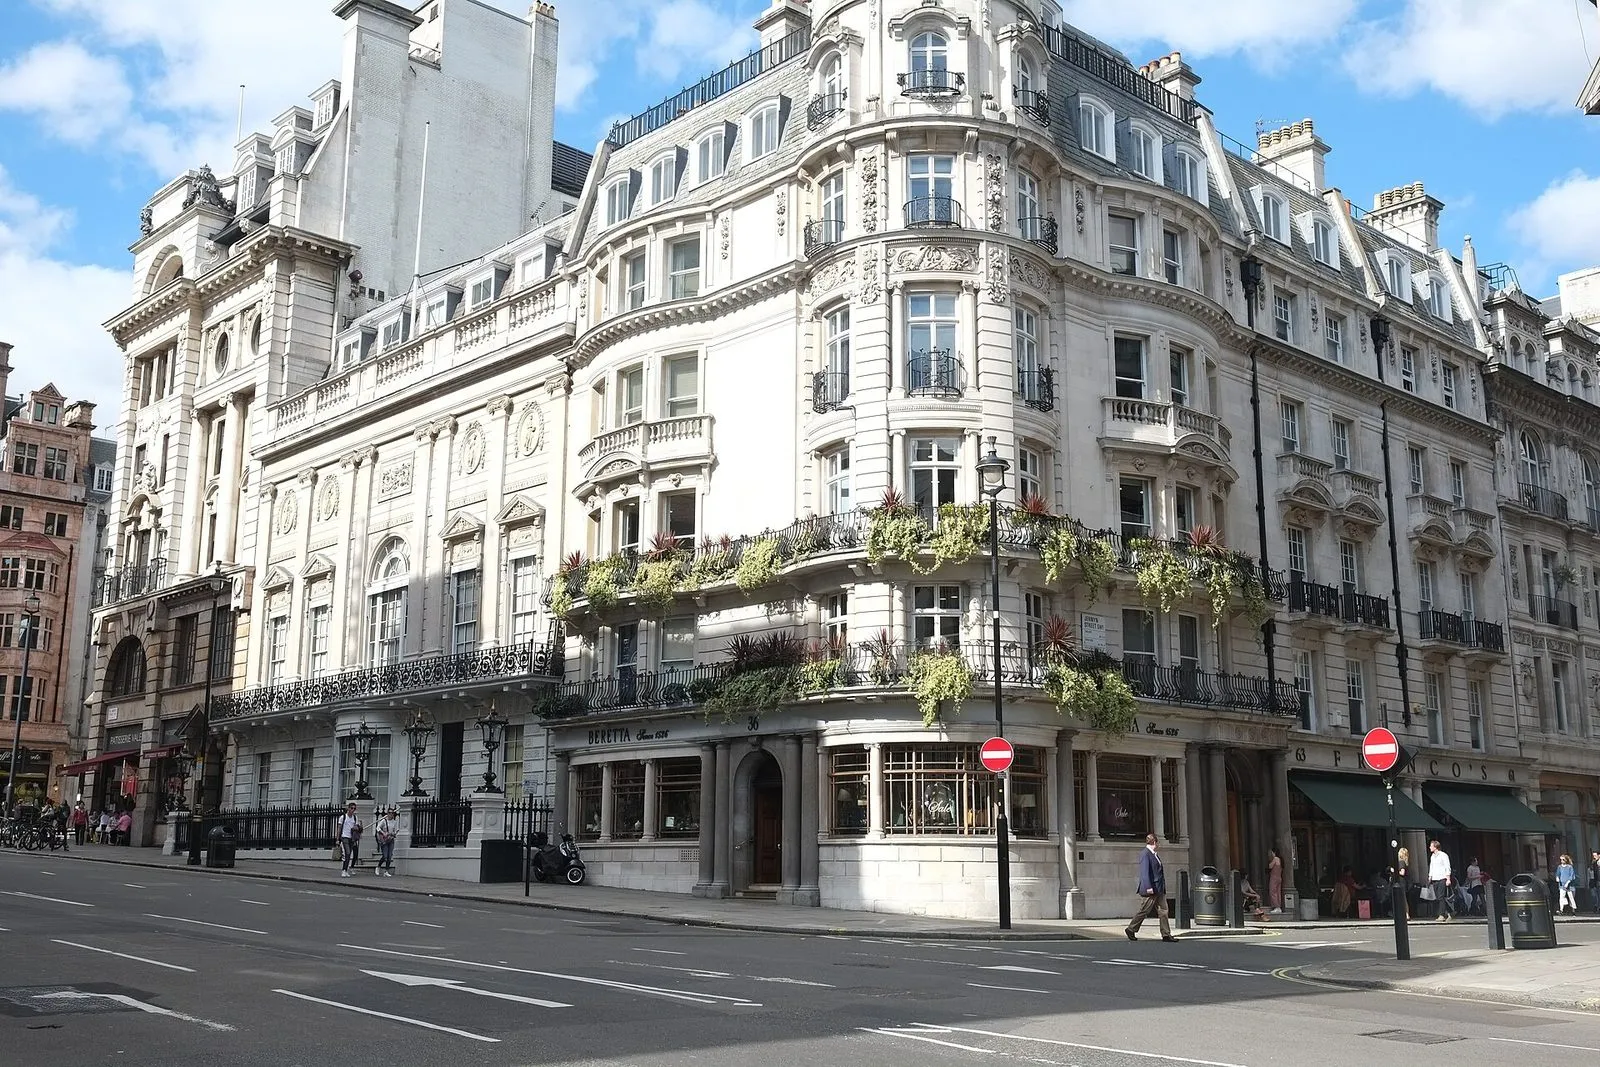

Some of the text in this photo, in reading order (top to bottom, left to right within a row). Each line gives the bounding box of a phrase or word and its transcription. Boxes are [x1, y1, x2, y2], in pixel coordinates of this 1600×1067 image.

[747, 715, 759, 731] 36
[1146, 721, 1164, 735] Since
[588, 727, 631, 745] BERETTA
[636, 728, 654, 741] Since
[1296, 748, 1307, 762] 63
[1333, 750, 1488, 781] FRNCO'S
[928, 799, 952, 814] Sale
